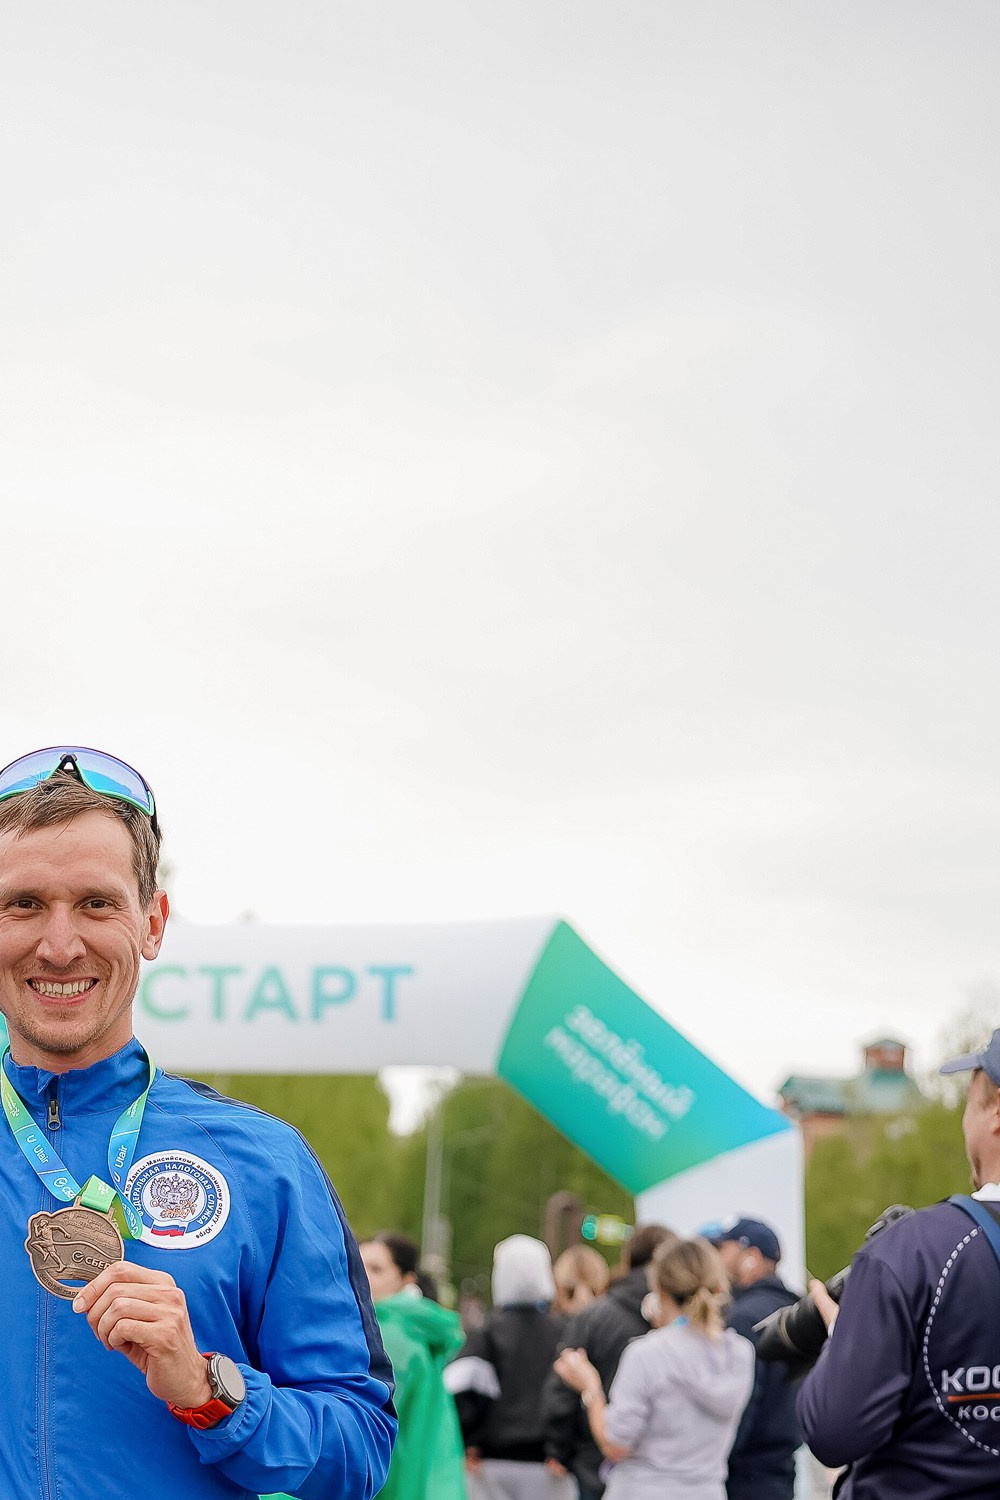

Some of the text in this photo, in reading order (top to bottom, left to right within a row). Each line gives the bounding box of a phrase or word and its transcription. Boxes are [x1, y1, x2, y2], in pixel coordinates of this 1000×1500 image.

[138, 964, 414, 1022] СТАРТ
[33, 1144, 49, 1164] Utair
[115, 1145, 128, 1168] Utair
[131, 1163, 215, 1225] ФЕДЕРАЛЬНАЯ НАЛОГОВАЯ СЛУЖБА
